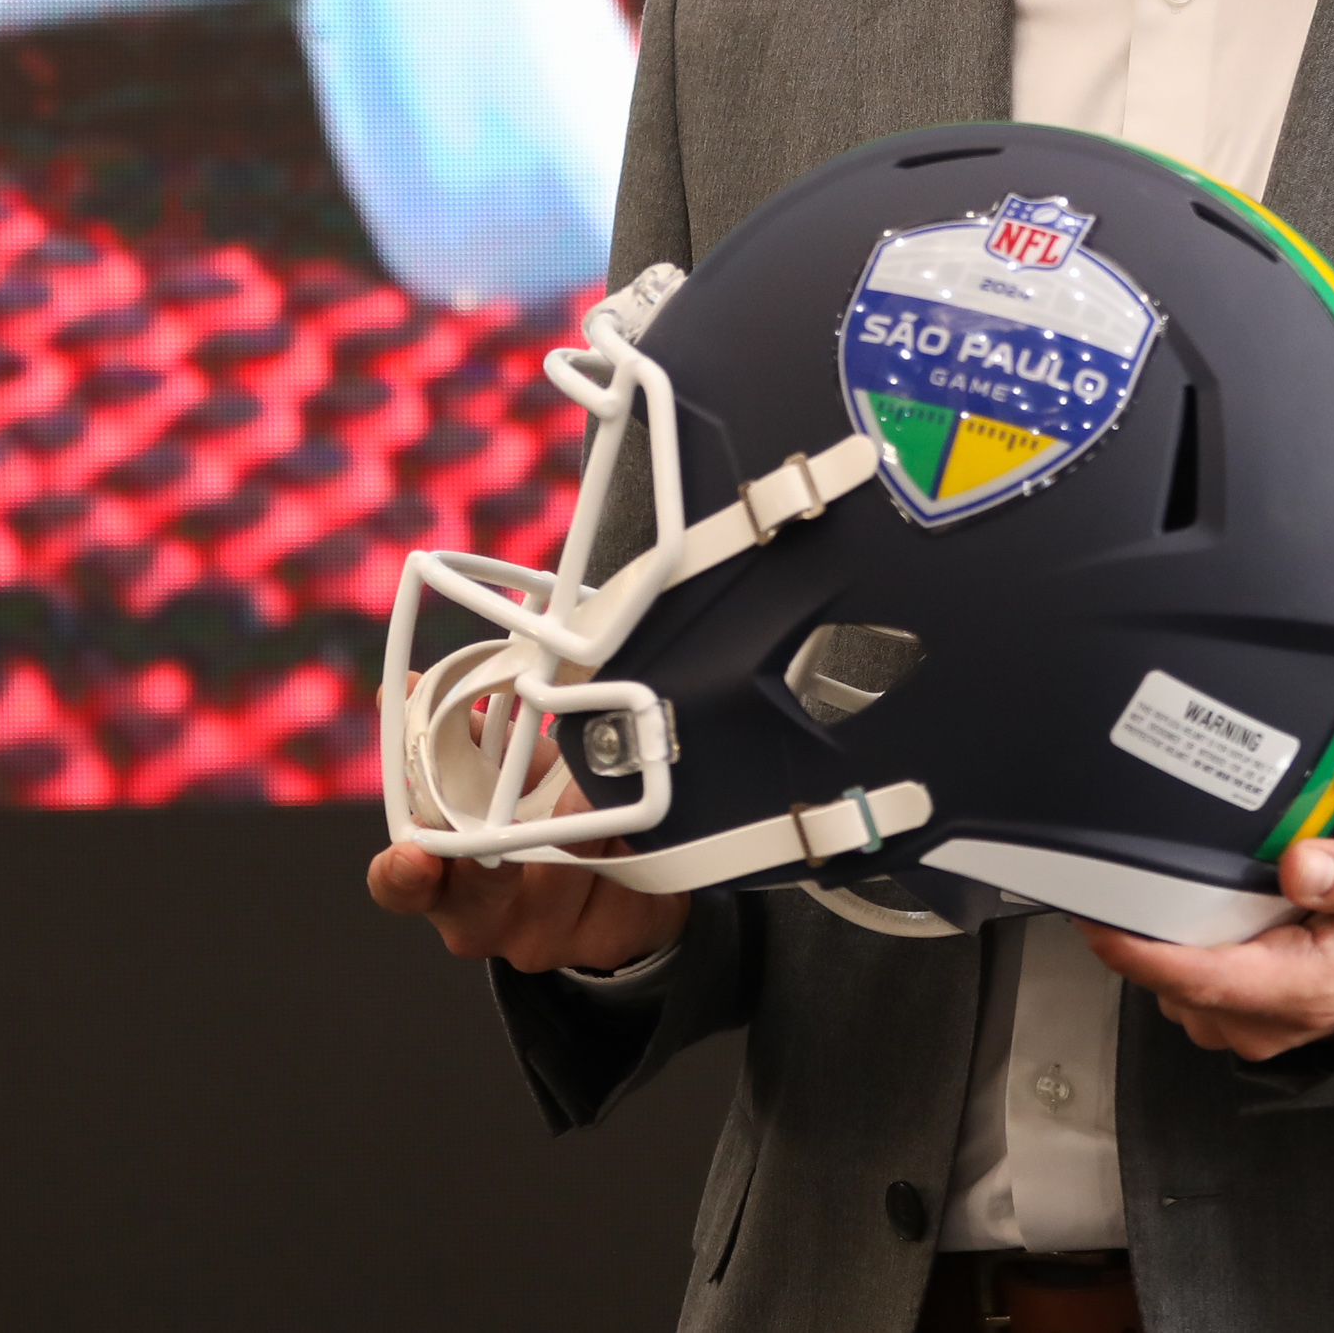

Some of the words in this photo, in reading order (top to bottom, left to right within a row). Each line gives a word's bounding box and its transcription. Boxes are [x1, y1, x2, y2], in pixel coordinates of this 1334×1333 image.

[993, 221, 1060, 265] NFL
[979, 277, 1033, 301] 2024
[858, 311, 951, 356] SÃO
[957, 333, 1108, 402] PAULO
[929, 367, 1011, 403] GAME
[1184, 699, 1264, 753] WARNING
